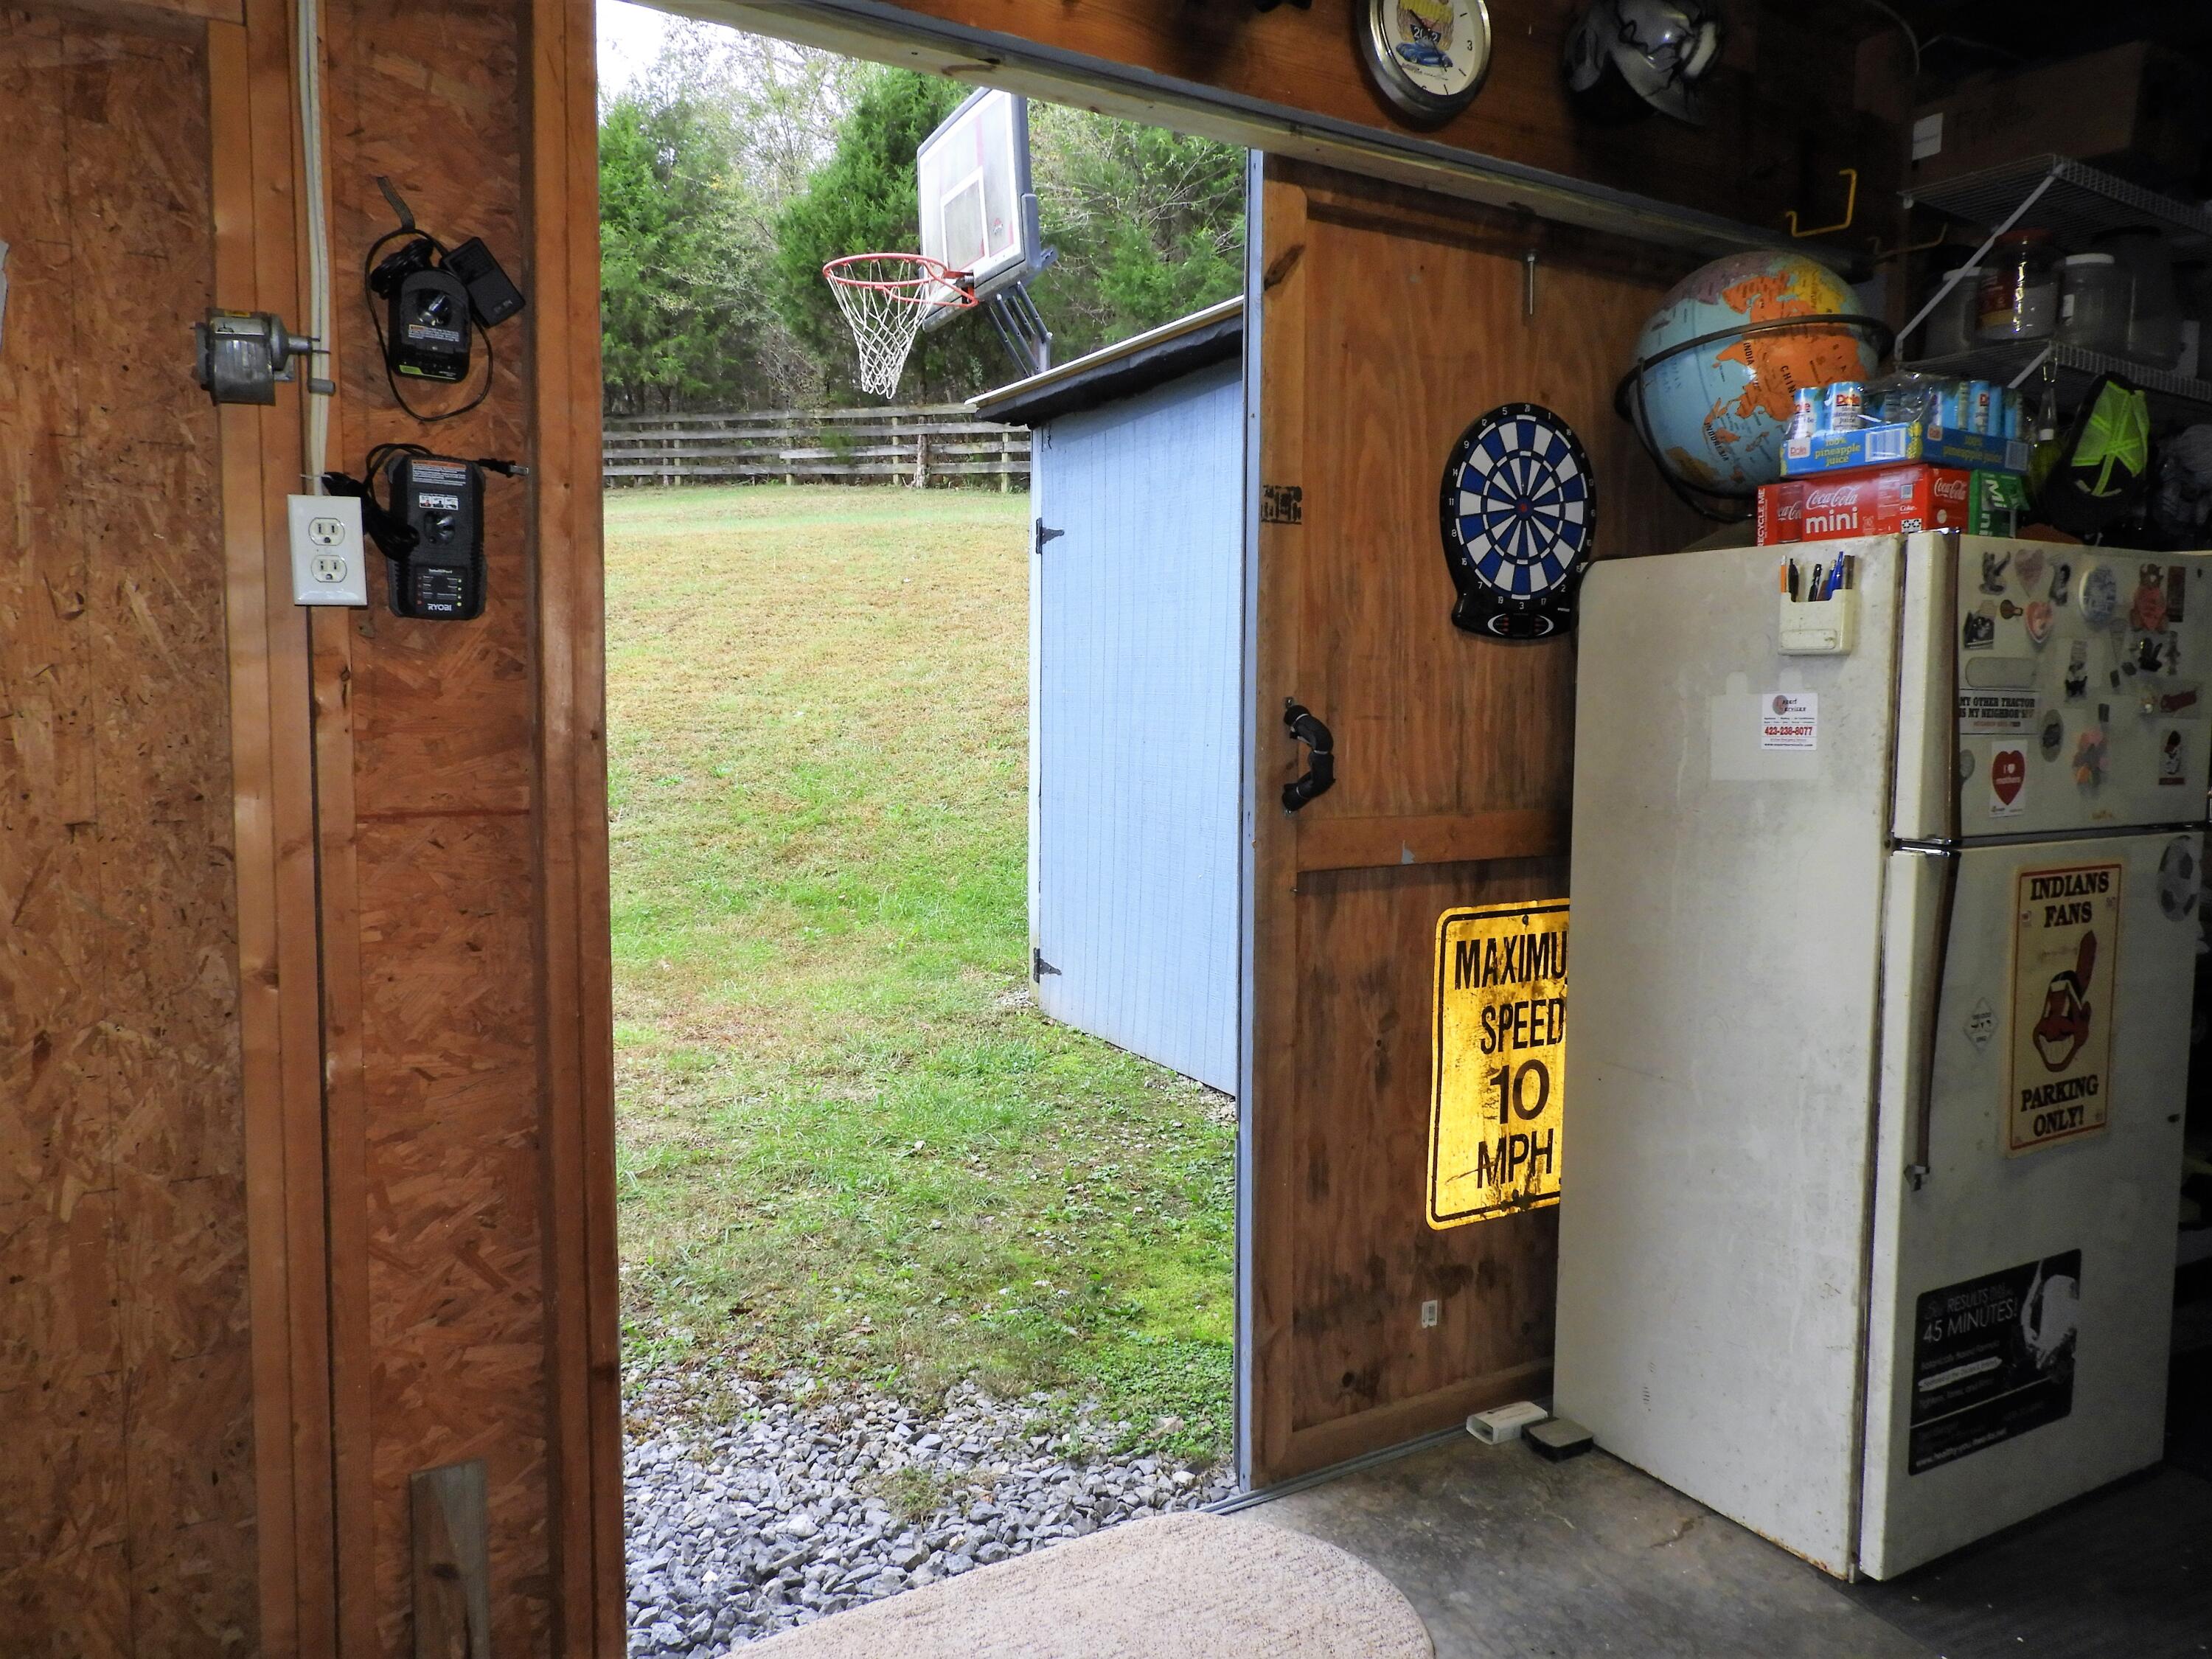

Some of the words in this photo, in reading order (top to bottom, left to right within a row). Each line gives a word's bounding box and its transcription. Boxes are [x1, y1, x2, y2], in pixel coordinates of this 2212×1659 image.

[1467, 40, 1472, 51] 3
[1743, 341, 1756, 366] INDIA
[1780, 364, 1797, 399] CHIN
[1815, 443, 1862, 458] pineapple
[1825, 455, 1850, 467] juice
[1758, 488, 1766, 504] ME
[1806, 485, 1863, 510] Coca-Cola
[1934, 477, 1967, 501] Coca-Cola
[1806, 507, 1859, 534] mini
[427, 603, 452, 611] RYOBI
[1968, 708, 1980, 718] MY
[1973, 696, 1999, 707] OTHER
[2001, 698, 2035, 708] TRACTOR
[2030, 871, 2110, 901] INDIANS
[2043, 901, 2093, 928] FANS
[1455, 931, 1568, 990] MAXIMU
[1481, 997, 1565, 1055] SPEED
[1489, 1059, 1549, 1124] 10
[2020, 1074, 2099, 1113] PARKING
[2033, 1105, 2084, 1136] ONLY!
[1477, 1128, 1553, 1189] MPH
[1922, 1318, 1944, 1343] 45
[1947, 1296, 2019, 1338] MINUTES!
